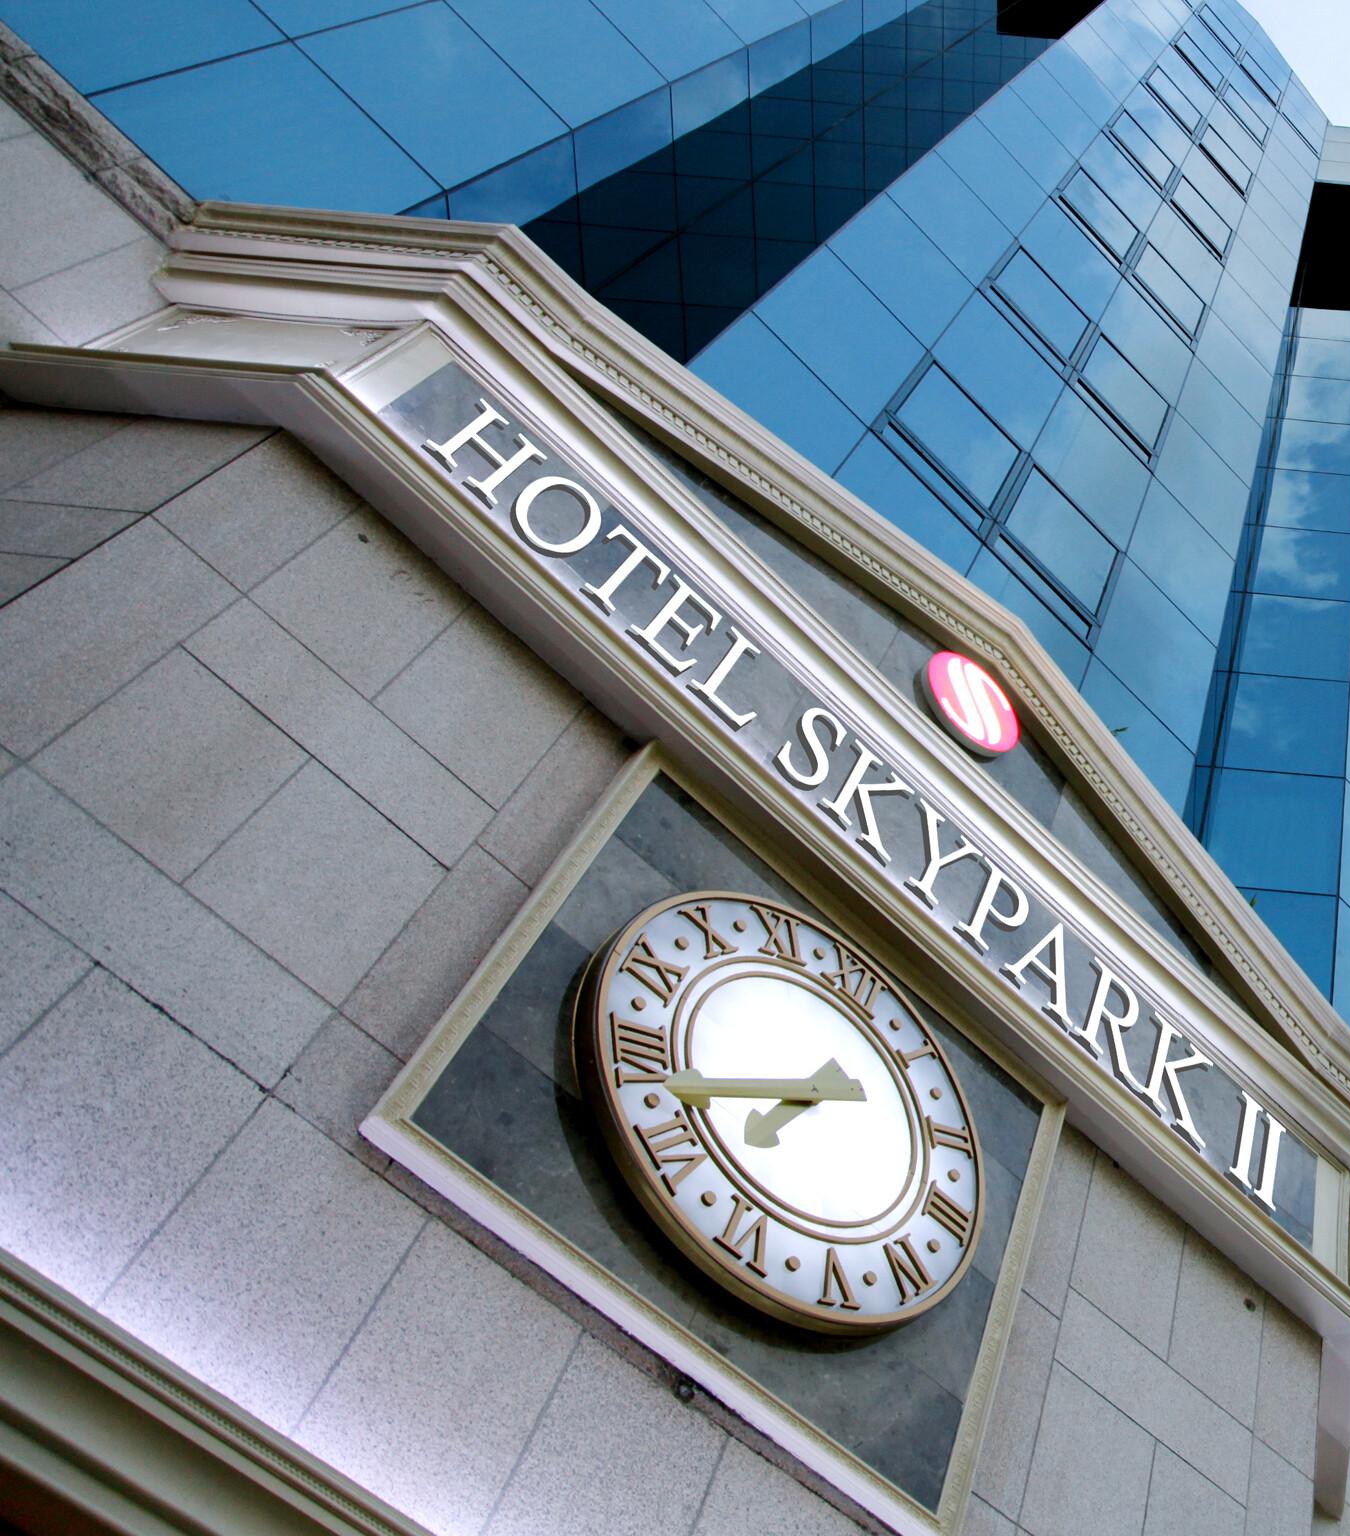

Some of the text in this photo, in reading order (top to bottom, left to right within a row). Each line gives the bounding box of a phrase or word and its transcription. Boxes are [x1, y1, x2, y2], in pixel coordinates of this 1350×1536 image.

[424, 398, 1287, 1212] HOTEL SKYPARK II
[677, 905, 739, 960] X
[750, 903, 807, 967] XI
[620, 933, 690, 1008] IX
[820, 942, 888, 1020] XII
[609, 1012, 677, 1088] VIII
[895, 1038, 938, 1068] I
[633, 1110, 708, 1196] VII
[925, 1115, 974, 1159] II
[713, 1193, 768, 1278] VI
[922, 1180, 974, 1247] III
[817, 1247, 861, 1310] V
[883, 1233, 938, 1305] IV
